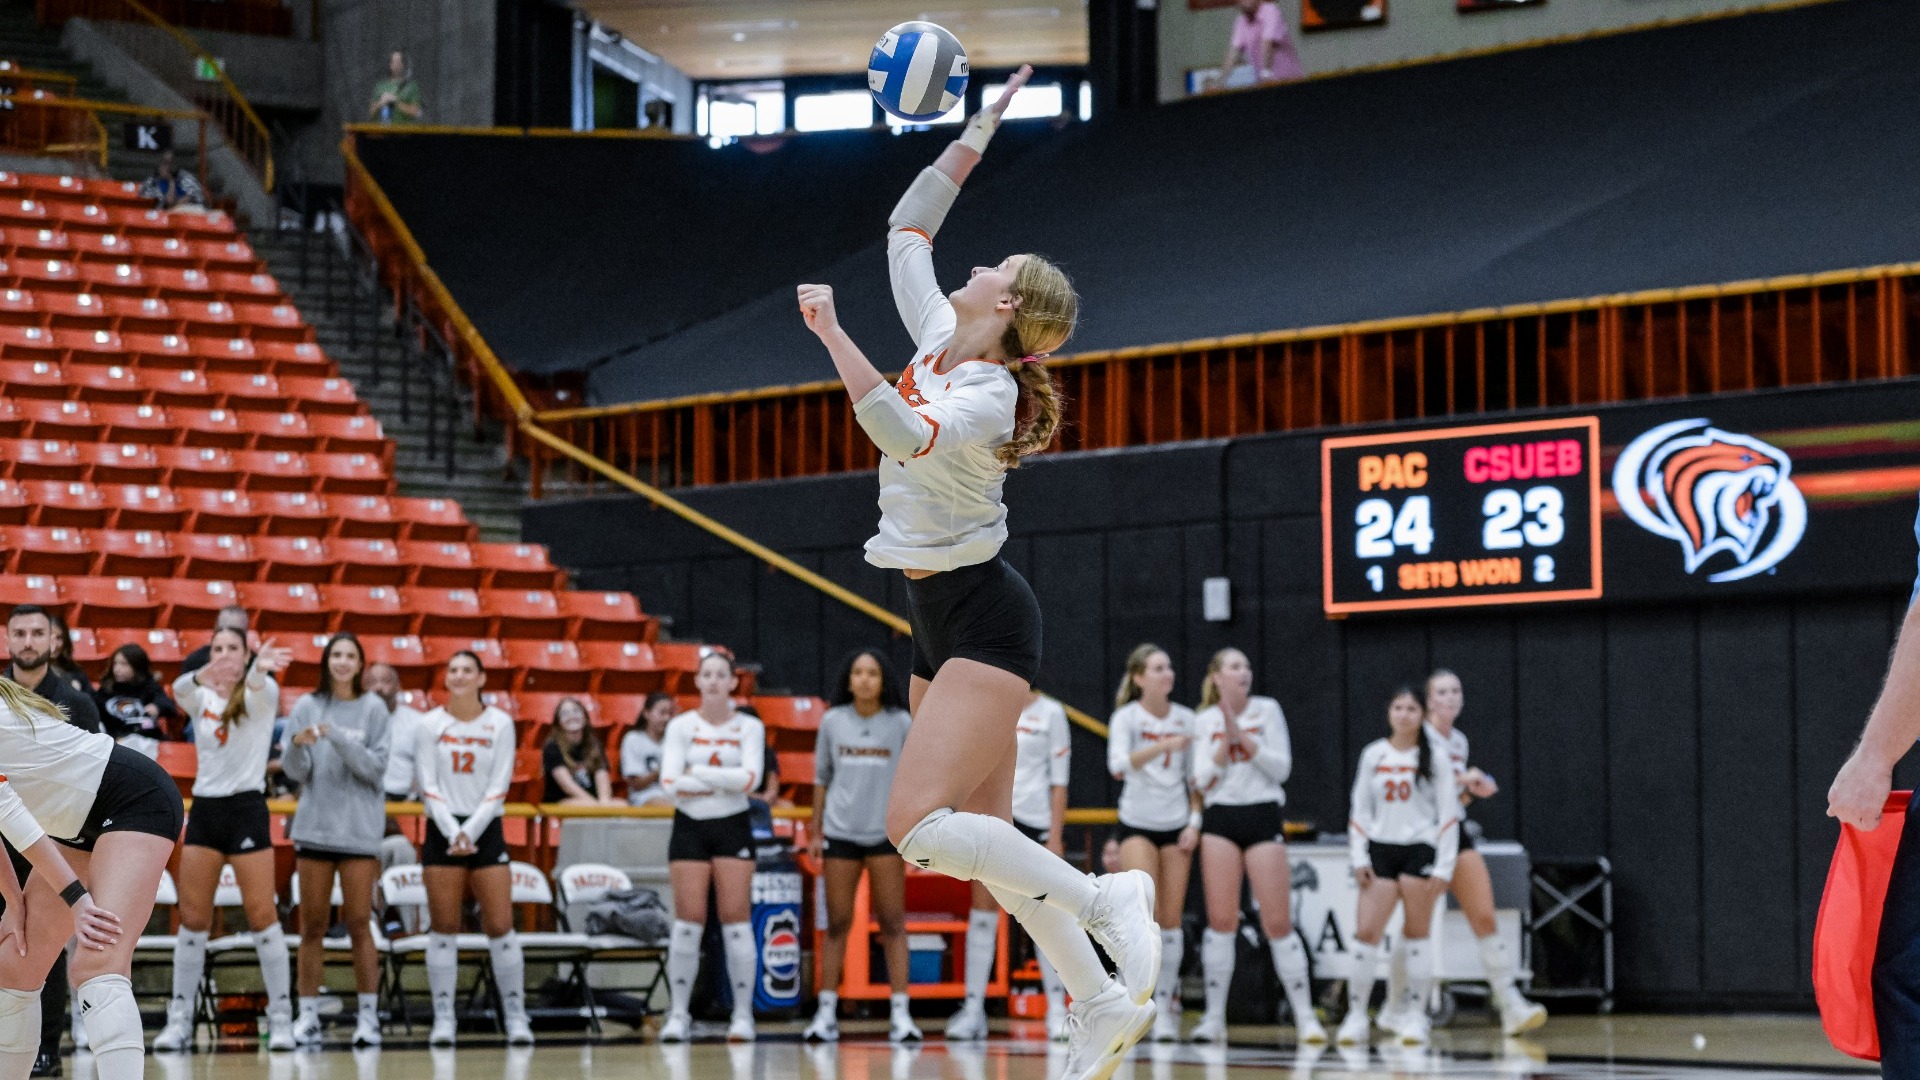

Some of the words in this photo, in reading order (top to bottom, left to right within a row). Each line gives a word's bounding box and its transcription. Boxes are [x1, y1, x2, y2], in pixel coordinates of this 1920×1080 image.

[137, 126, 158, 149] K
[1359, 452, 1428, 491] PAC
[1464, 440, 1582, 483] CSUEB
[1356, 496, 1434, 558] 24
[1483, 486, 1565, 549] 23
[1366, 565, 1384, 592] 1
[1398, 561, 1458, 590] SETS
[1459, 557, 1521, 587] WON
[1533, 555, 1555, 582] 2
[214, 727, 228, 747] 9
[452, 751, 475, 774] 12
[1384, 781, 1411, 802] 20
